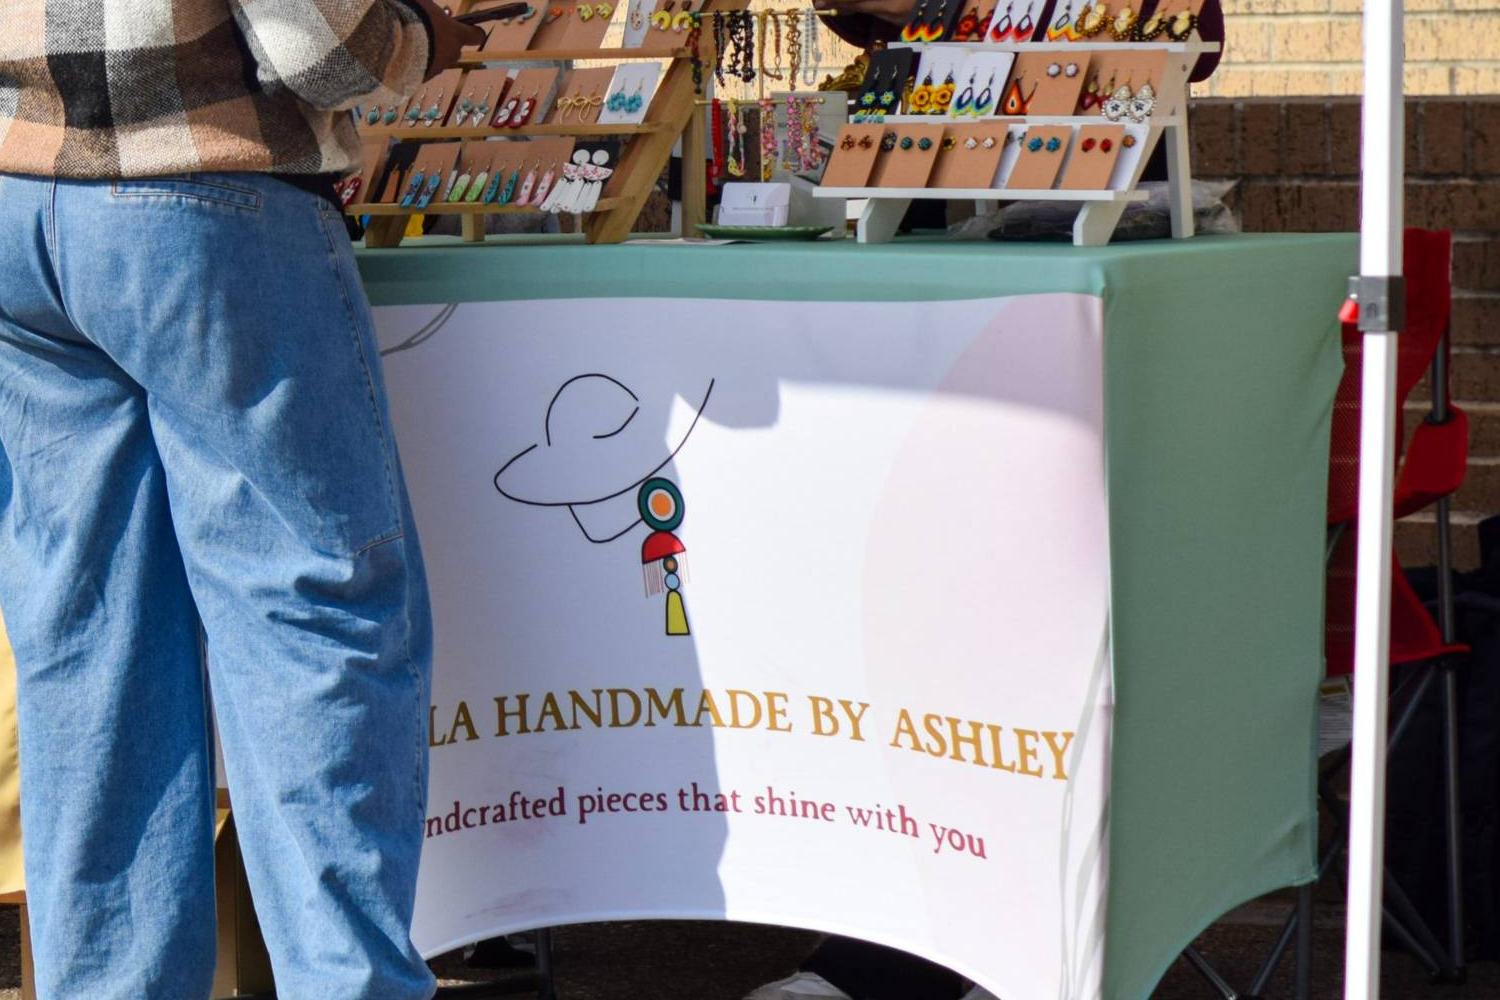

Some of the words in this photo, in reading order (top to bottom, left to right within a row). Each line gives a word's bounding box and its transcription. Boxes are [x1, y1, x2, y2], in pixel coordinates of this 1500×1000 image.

[493, 687, 793, 738] HANDMADE
[807, 695, 870, 742] BY
[889, 707, 1075, 780] ASHLEY
[426, 786, 566, 838] ndcrafted
[577, 786, 668, 825] pieces
[677, 782, 742, 814] that
[754, 785, 836, 822] shine
[846, 803, 919, 838] with
[929, 821, 987, 860] you
